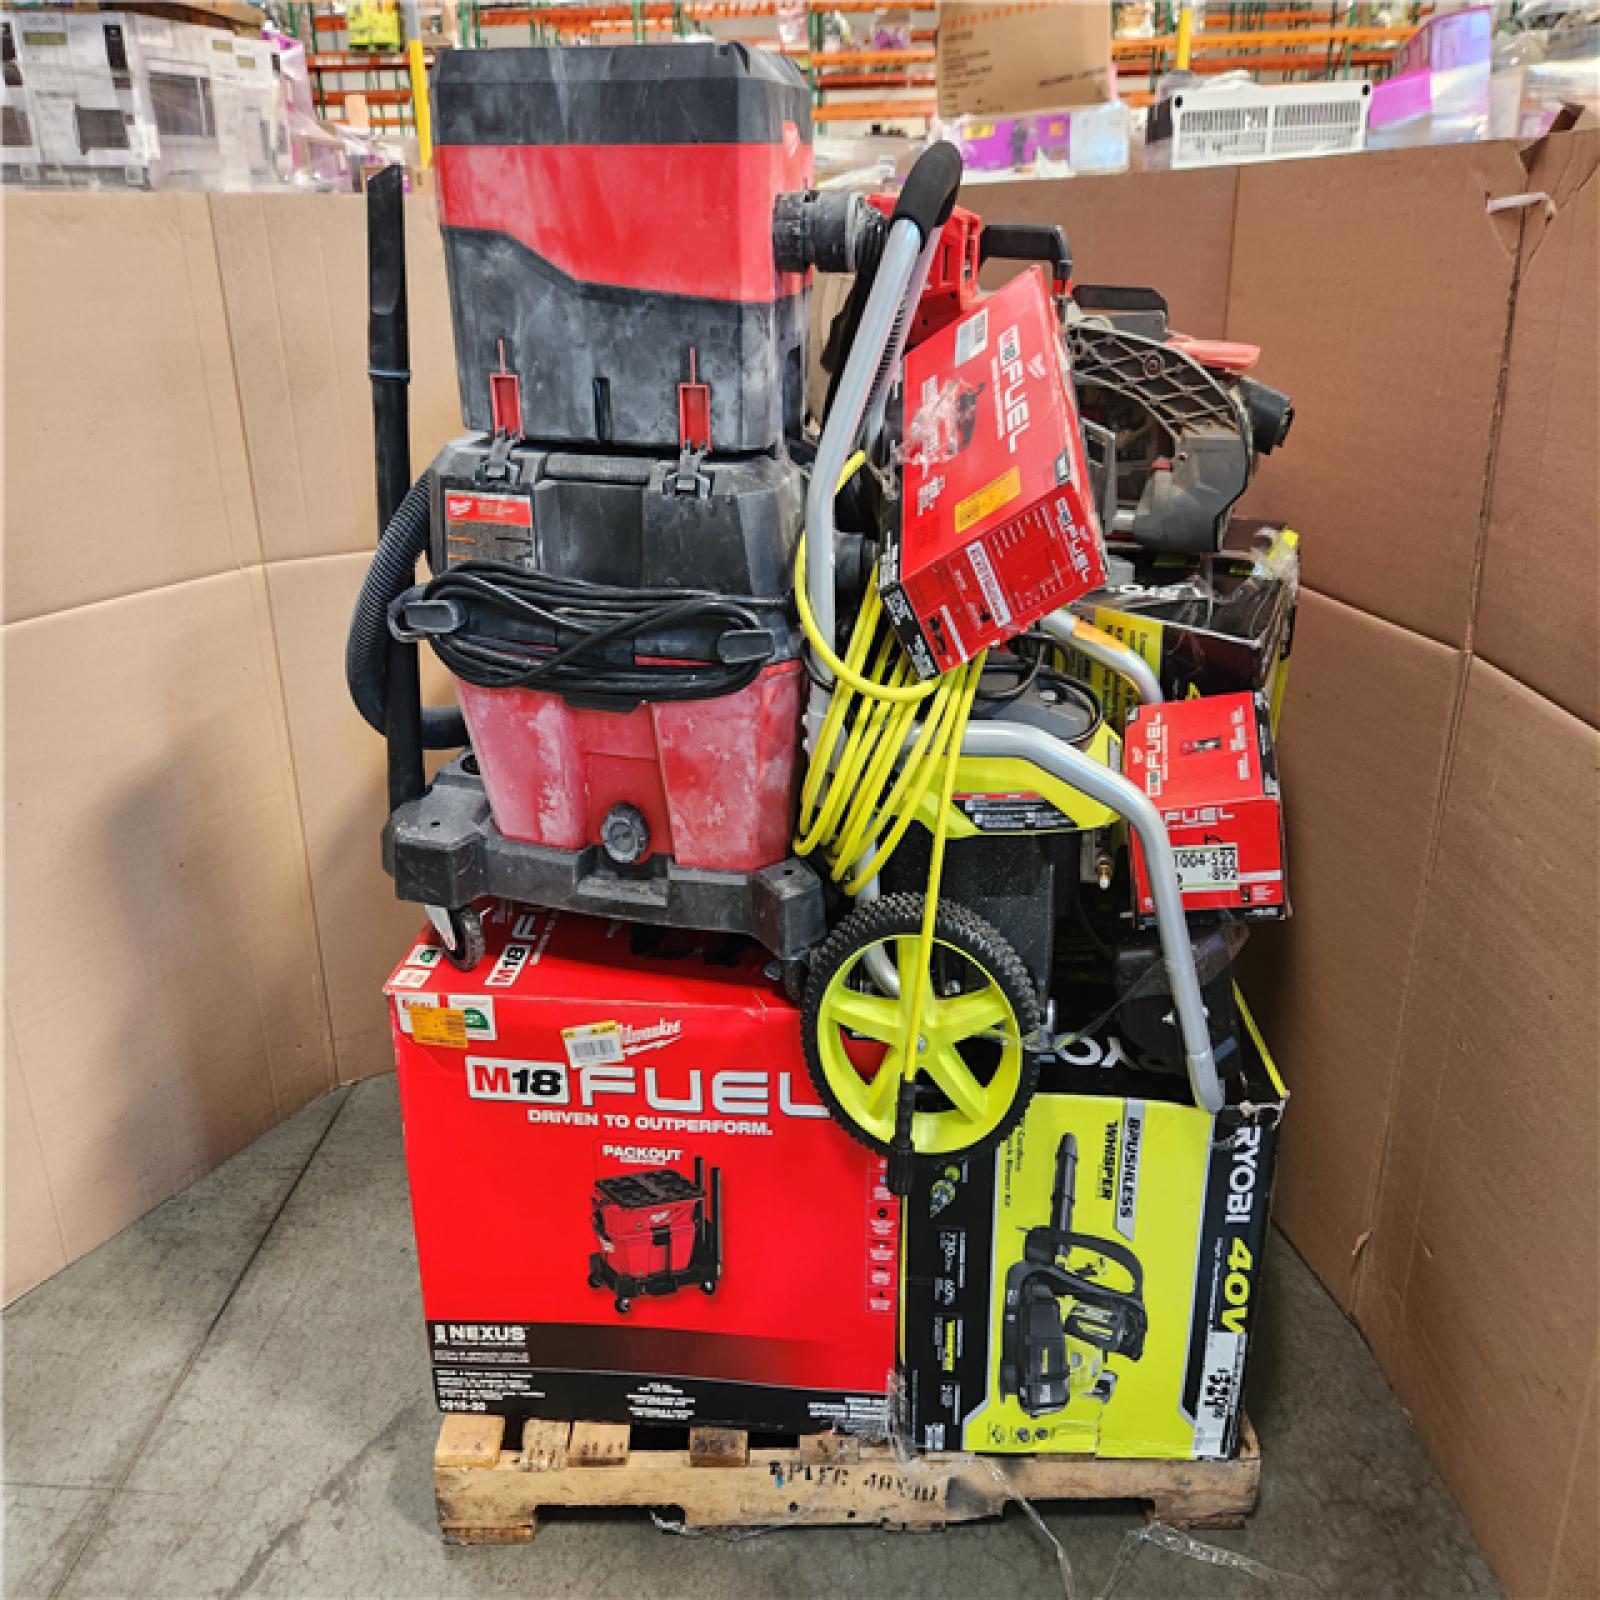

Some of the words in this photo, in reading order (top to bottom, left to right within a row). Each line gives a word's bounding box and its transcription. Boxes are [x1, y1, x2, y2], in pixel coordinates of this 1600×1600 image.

[1145, 712, 1161, 770] FUEL
[474, 1065, 562, 1098] M18
[580, 1065, 831, 1118] FUEL
[528, 1109, 598, 1127] DRIVEN
[604, 1113, 630, 1129] TO
[635, 1115, 773, 1137] OUTPERFORM.
[601, 1144, 683, 1162] PACKOUT
[1101, 1119, 1118, 1202] WHISPER
[1120, 1117, 1141, 1219] BRUSHLESS
[1226, 1125, 1262, 1224] RYOBI
[1220, 1237, 1252, 1334] 40V
[449, 1324, 526, 1342] NEXUS
